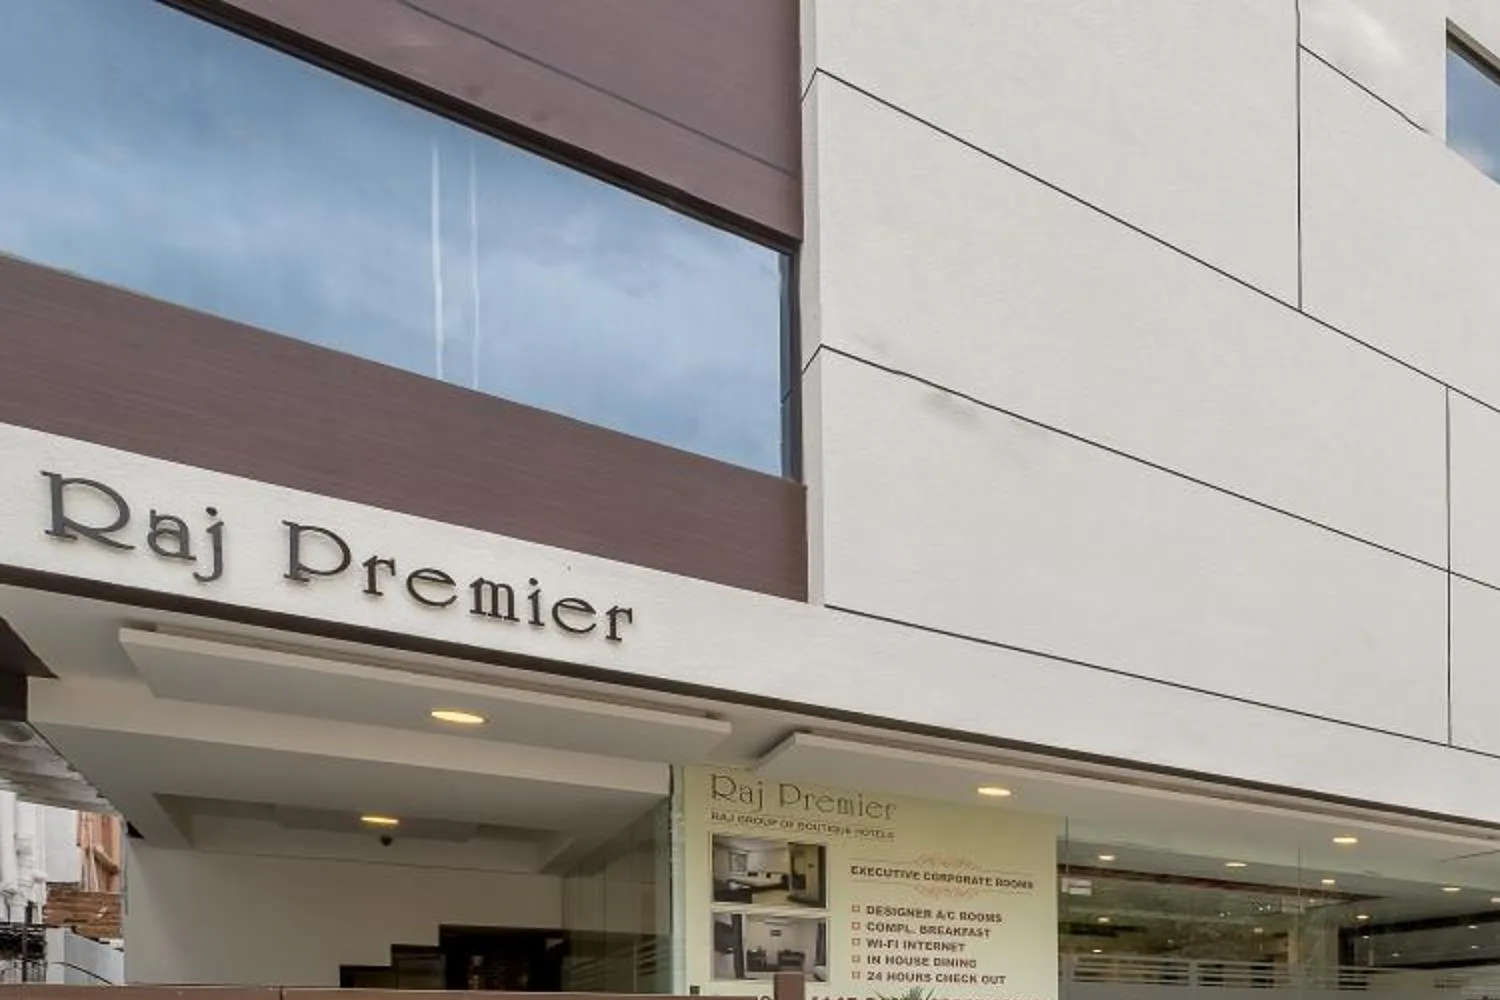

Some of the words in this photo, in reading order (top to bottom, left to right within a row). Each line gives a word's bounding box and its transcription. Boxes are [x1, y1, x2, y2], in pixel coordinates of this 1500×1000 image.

[41, 471, 225, 582] Raj
[282, 521, 633, 642] Premier
[711, 773, 763, 812] Raj
[779, 783, 897, 820] Premier
[711, 811, 735, 822] RAJ
[850, 865, 920, 881] EXECUTIVE
[923, 871, 993, 888] CORPORATE
[995, 879, 1034, 890] ROOMS
[866, 904, 932, 919] DESIGNER
[959, 911, 1003, 923] ROOMS
[919, 926, 992, 939] BREAKFAST
[866, 938, 900, 950] WI-FI
[902, 939, 966, 952] INTERNET
[867, 954, 882, 965] IN
[885, 955, 930, 967] HOUSE
[933, 957, 977, 969] DINING
[867, 971, 882, 982] 24
[886, 971, 932, 983] HOURS
[935, 973, 978, 984] CHECK
[981, 974, 1007, 985] OUT
